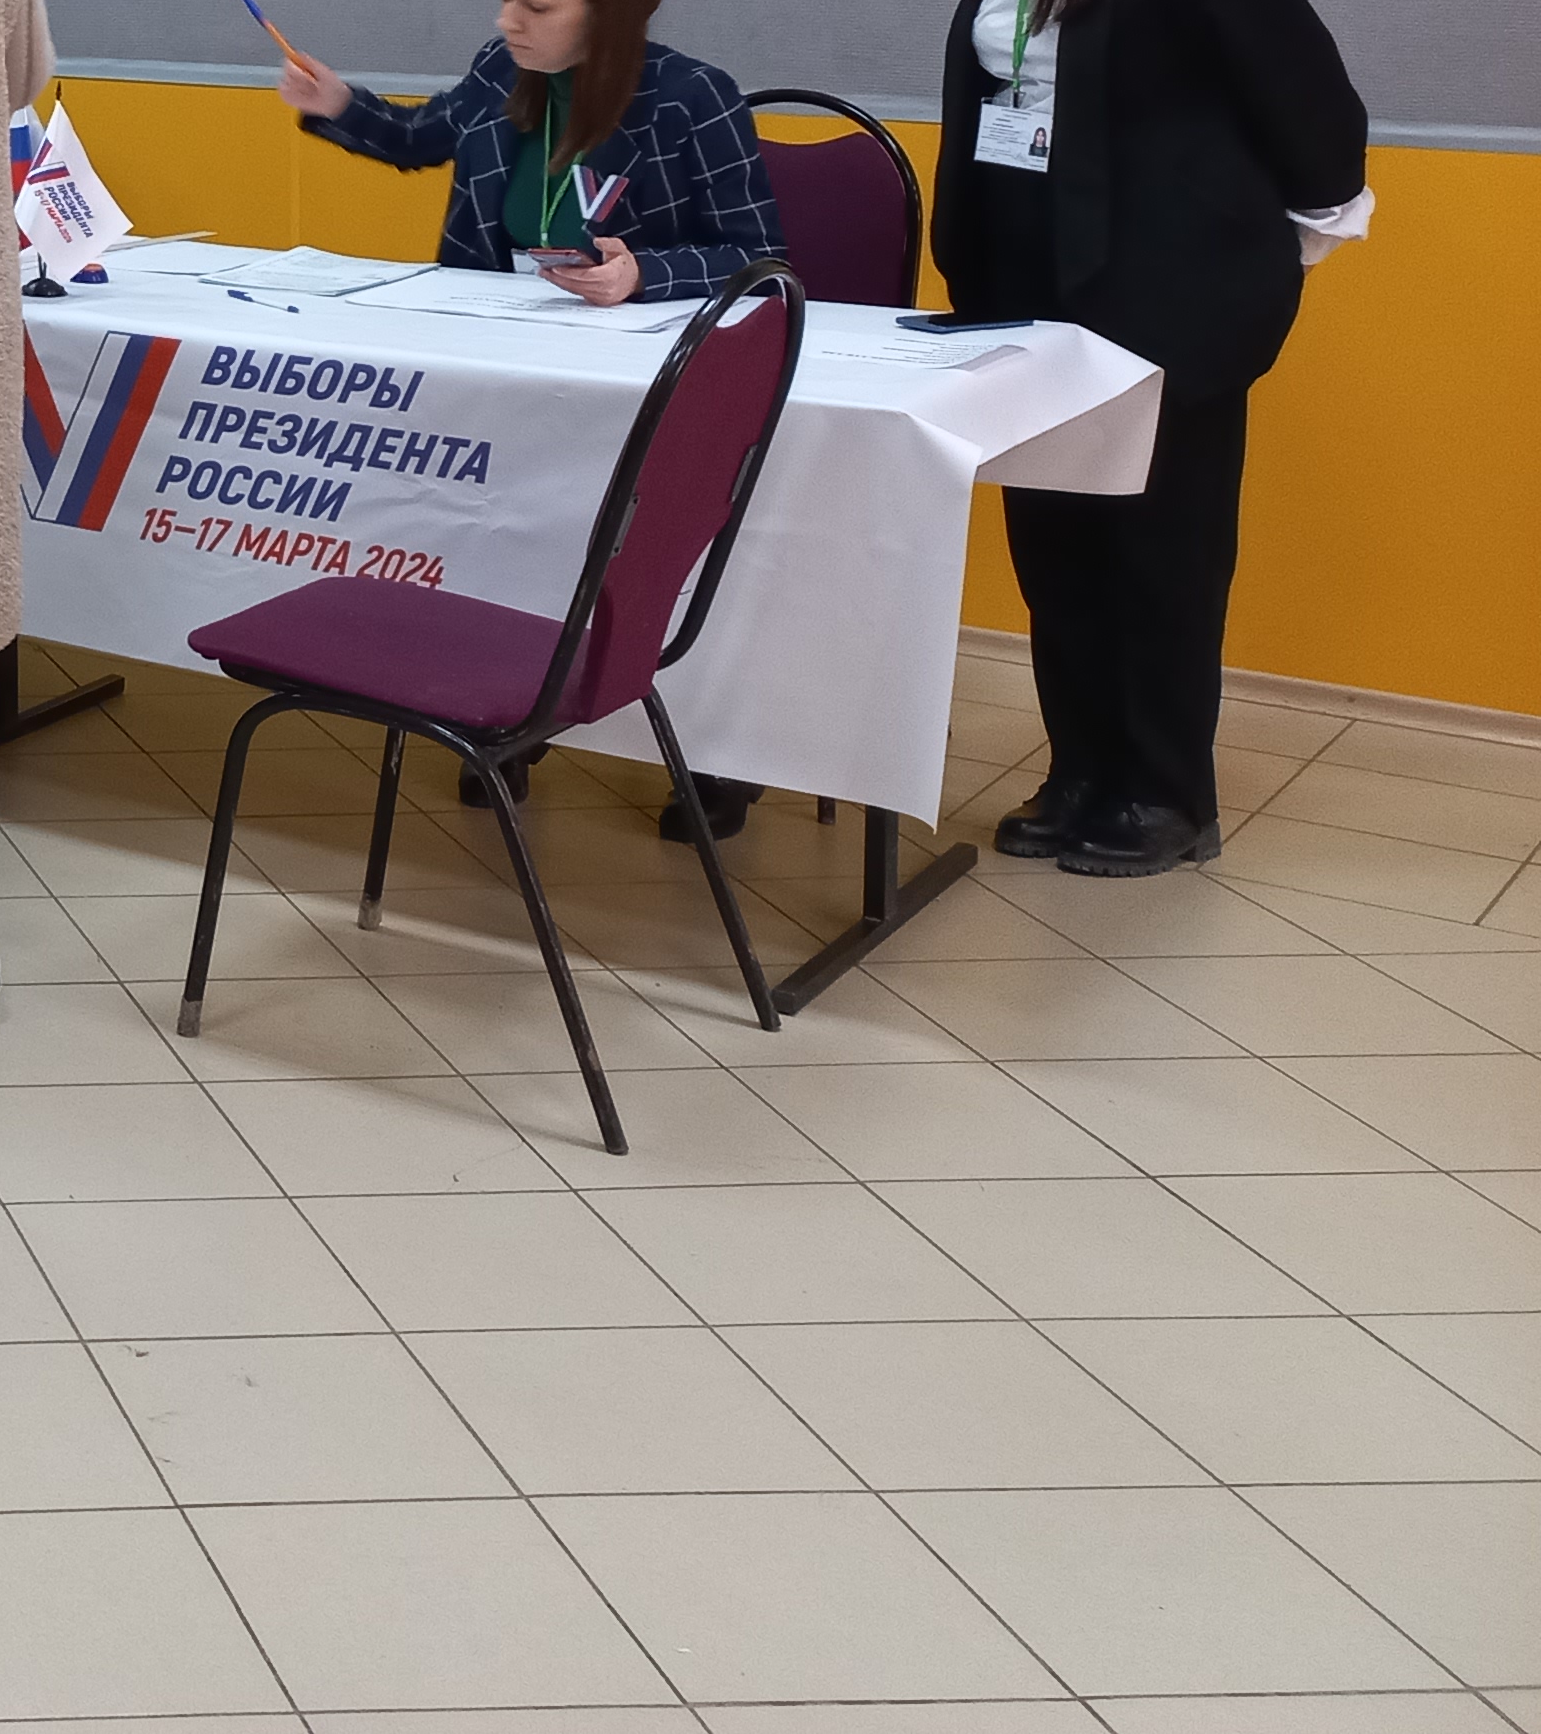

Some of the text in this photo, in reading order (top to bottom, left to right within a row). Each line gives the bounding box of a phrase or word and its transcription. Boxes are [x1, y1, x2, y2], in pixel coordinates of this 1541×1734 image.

[201, 346, 424, 412] ВЫБОРЫ
[179, 401, 493, 484] ПРЕЗИДЕНТА
[155, 455, 352, 522] РОССИИ
[233, 524, 352, 576] МАРТА
[356, 545, 446, 589] 2024
